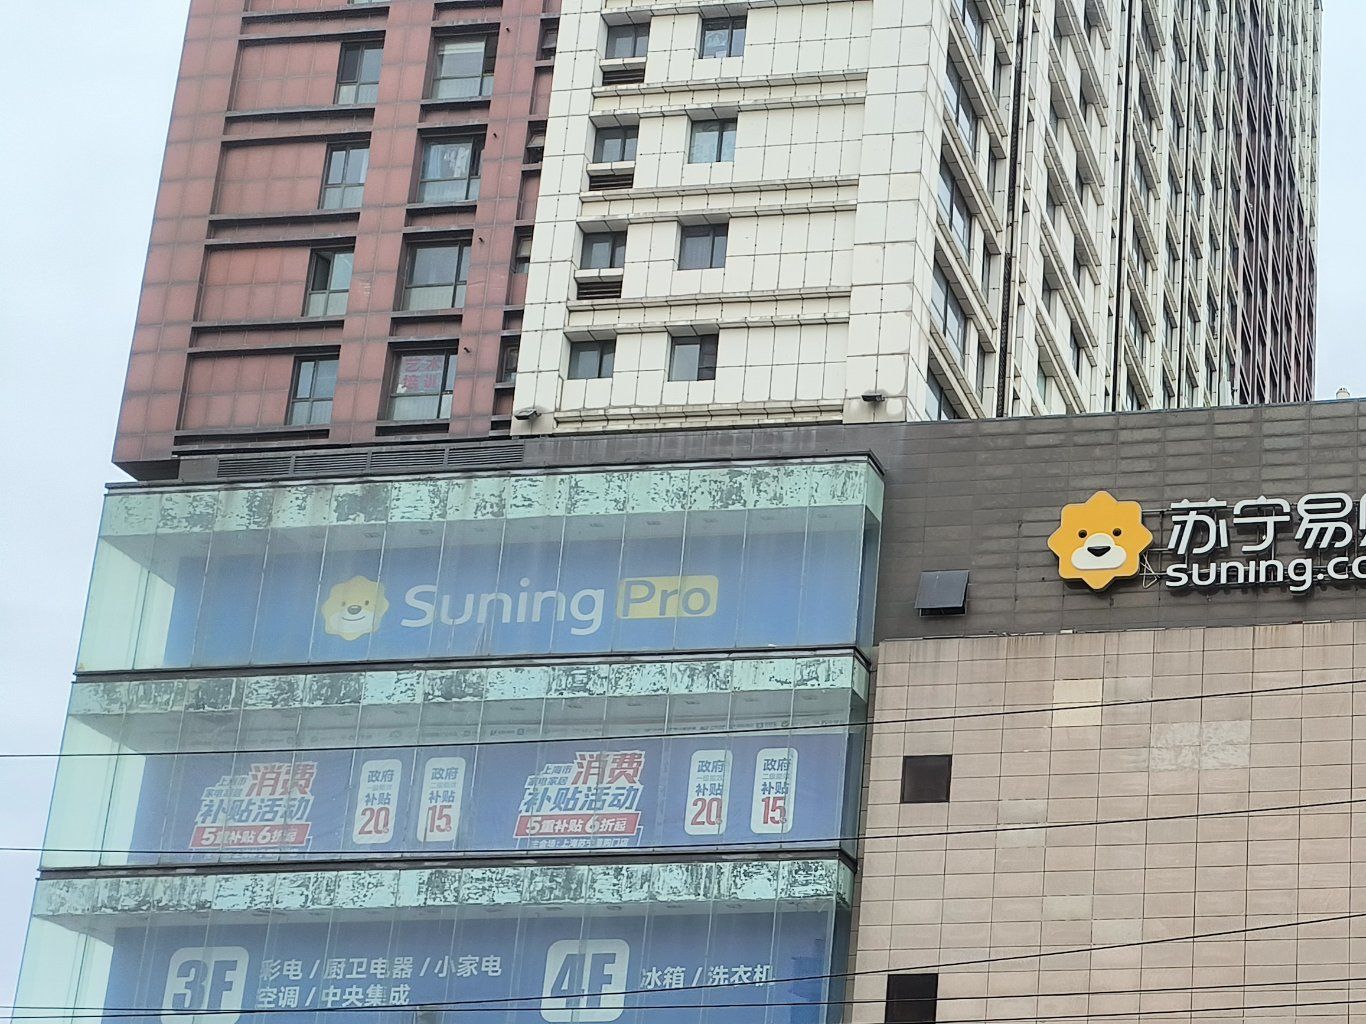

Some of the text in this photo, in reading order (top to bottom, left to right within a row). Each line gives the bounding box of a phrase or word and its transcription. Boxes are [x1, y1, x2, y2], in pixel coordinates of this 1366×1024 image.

[400, 577, 711, 636] Suning Pro
[368, 769, 395, 783] 政府
[431, 768, 459, 780] 政府
[571, 753, 642, 785] 消费
[697, 760, 726, 773] 政府
[763, 758, 791, 771] 政府
[245, 763, 316, 797] 消费
[695, 783, 724, 796] 补贴
[761, 781, 790, 795] 补贴
[365, 792, 392, 806] 补贴
[429, 790, 456, 804] 补贴
[520, 786, 640, 813] 补贴活动
[196, 797, 313, 824] 补贴活动
[433, 955, 502, 977] 小家电
[641, 965, 686, 989] 冰箱
[708, 964, 776, 986] 洗衣机
[172, 959, 237, 1010] 3F
[551, 952, 617, 1009] 4F
[257, 986, 300, 1008] 空调
[320, 984, 411, 1006] 中央集成
